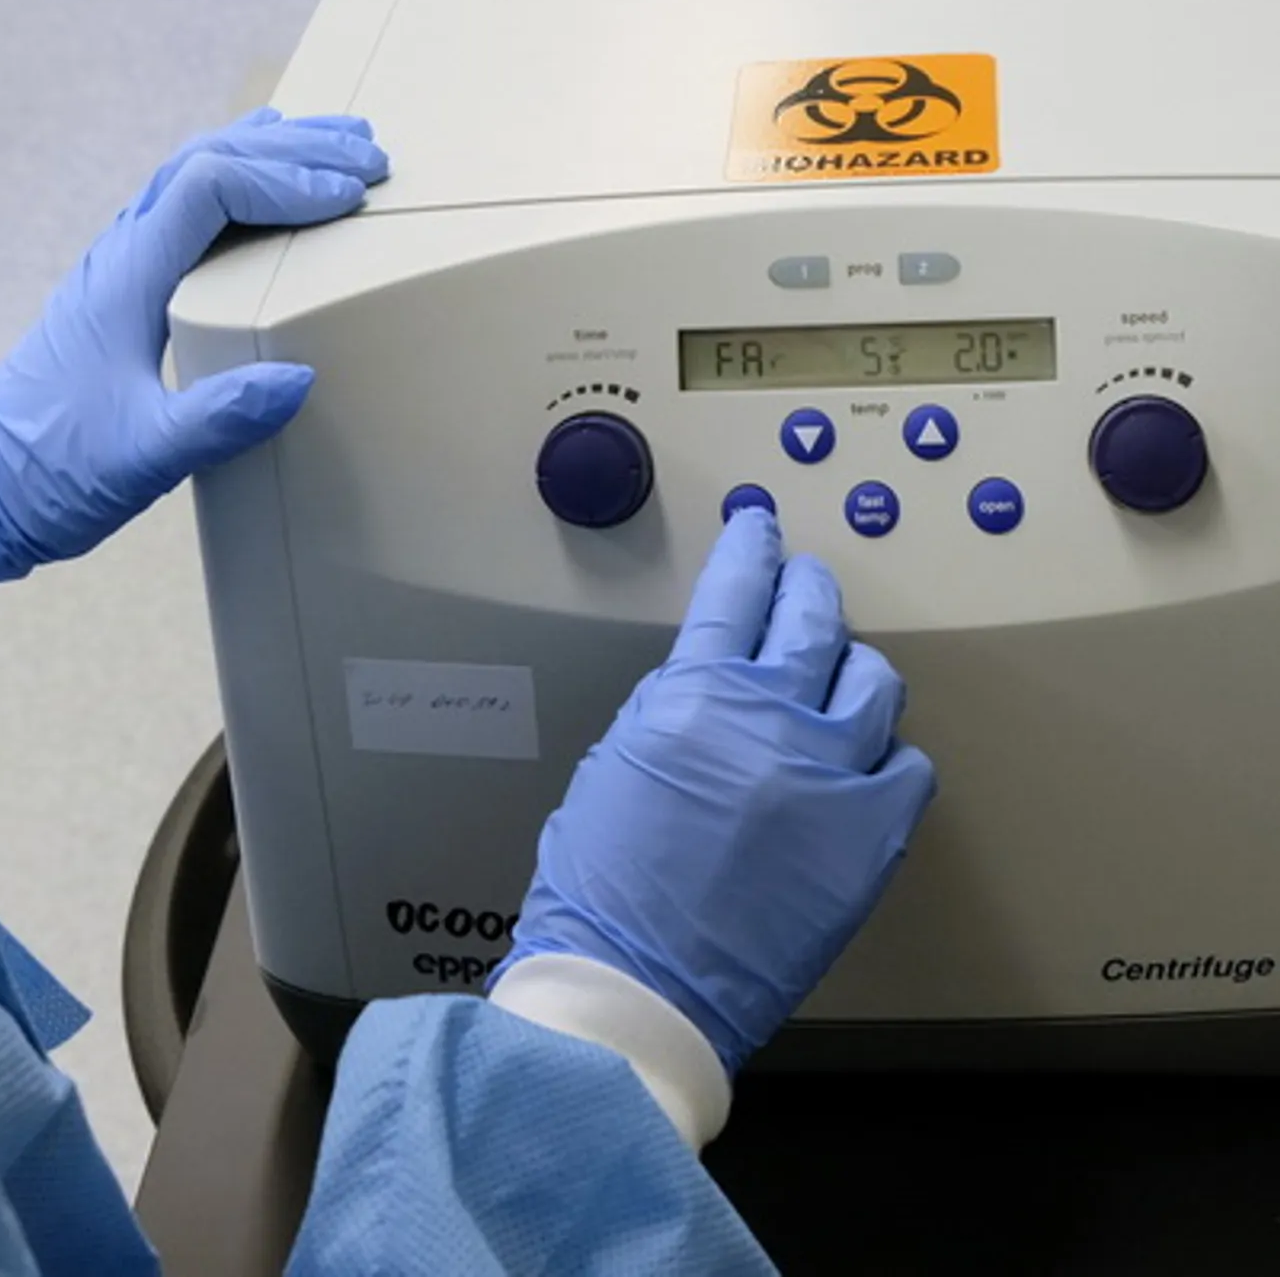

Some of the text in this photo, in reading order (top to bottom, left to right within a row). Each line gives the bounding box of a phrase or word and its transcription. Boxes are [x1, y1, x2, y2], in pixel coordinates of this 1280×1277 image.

[762, 150, 991, 173] IOHAZARD
[847, 262, 884, 278] prog
[1121, 309, 1169, 327] speed
[573, 328, 609, 342] time
[850, 402, 891, 419] temp
[857, 494, 885, 508] fast
[978, 499, 1016, 516] open
[853, 510, 890, 526] temp
[1100, 955, 1275, 983] Centrifuge
